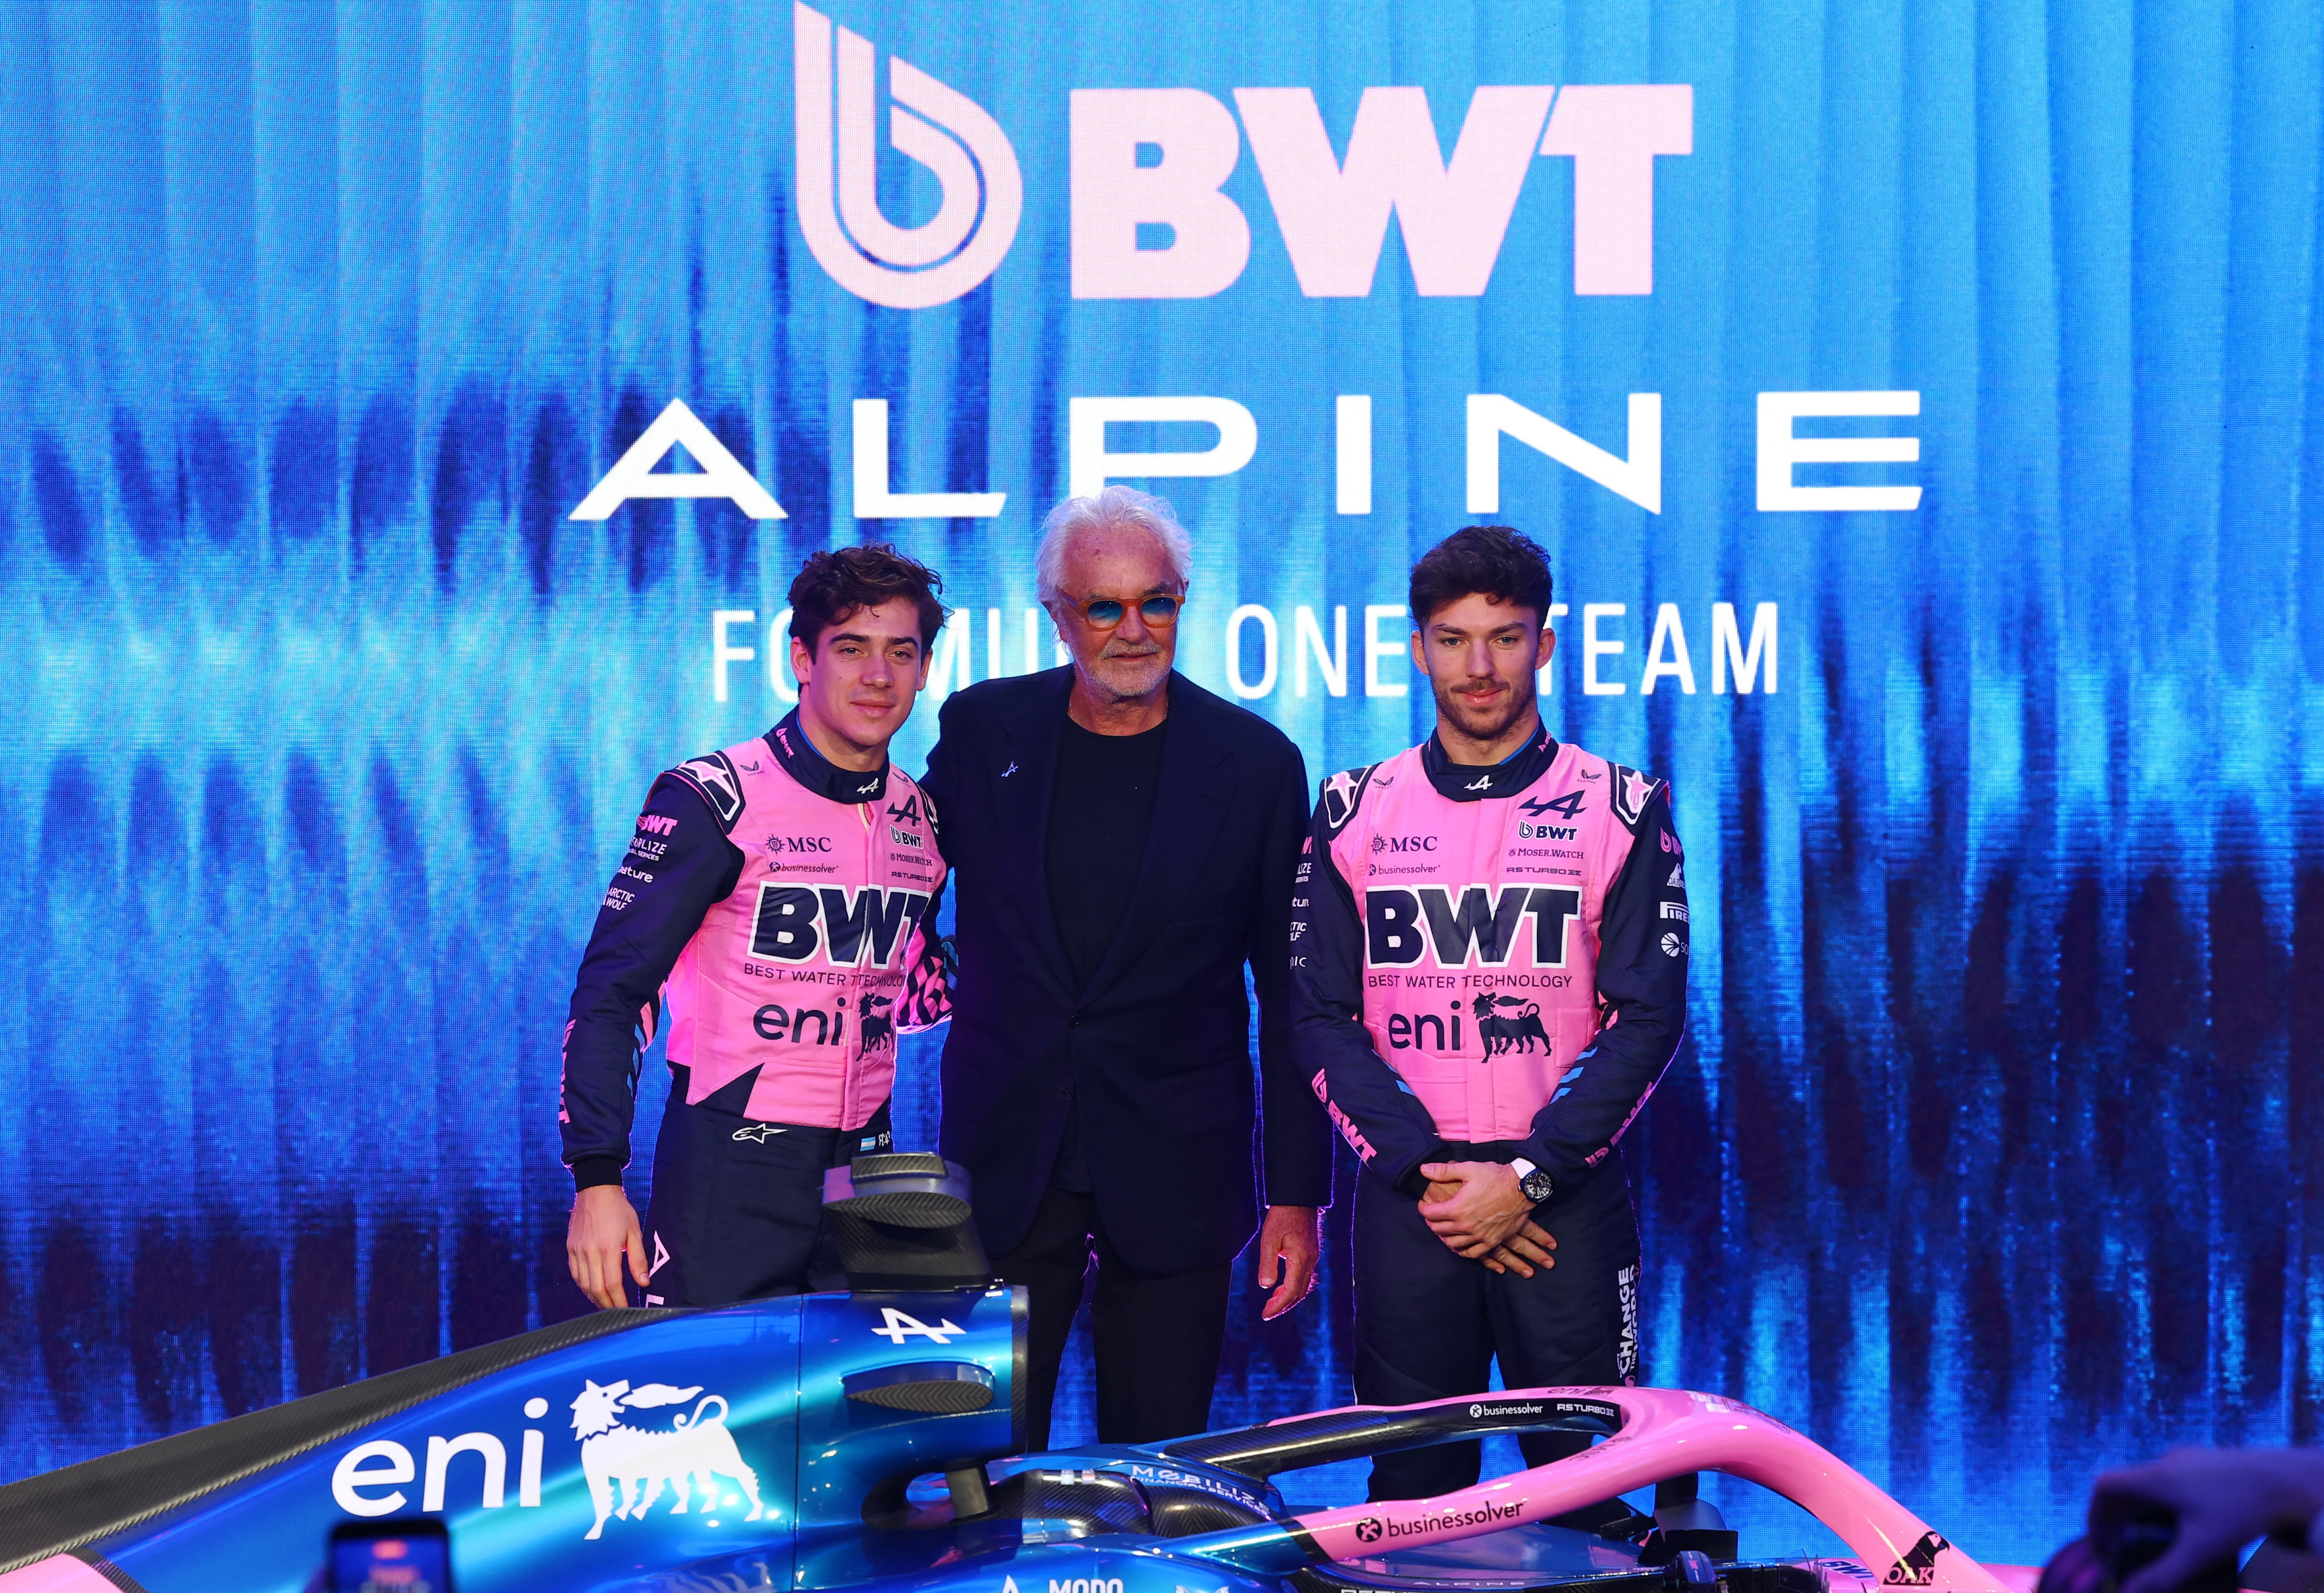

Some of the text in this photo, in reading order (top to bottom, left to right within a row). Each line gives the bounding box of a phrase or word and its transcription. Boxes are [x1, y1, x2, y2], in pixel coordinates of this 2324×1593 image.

[1070, 84, 1693, 300] BWT
[568, 391, 1923, 520] ALPINE
[1226, 604, 1406, 699] ONE
[901, 830, 924, 849] BWT
[1535, 824, 1578, 841] BWT
[786, 837, 832, 852] MSC
[1389, 836, 1438, 852] MSC
[781, 863, 836, 874] businessolver
[1379, 863, 1438, 875] businessolver
[606, 897, 627, 911] WOLF
[608, 887, 635, 902] ARCTIC
[1365, 882, 1583, 969] BWT
[744, 963, 786, 980] BEST
[791, 971, 846, 986] WATER
[1368, 974, 1573, 988] BEST WATER TECHNOLOGY
[753, 997, 846, 1046] eni
[1388, 1001, 1461, 1051] eni
[1618, 1267, 1634, 1375] CHANGE
[1484, 1402, 1543, 1416] businessolver
[331, 1397, 548, 1517] eni
[1387, 1501, 1524, 1538] businessolver
